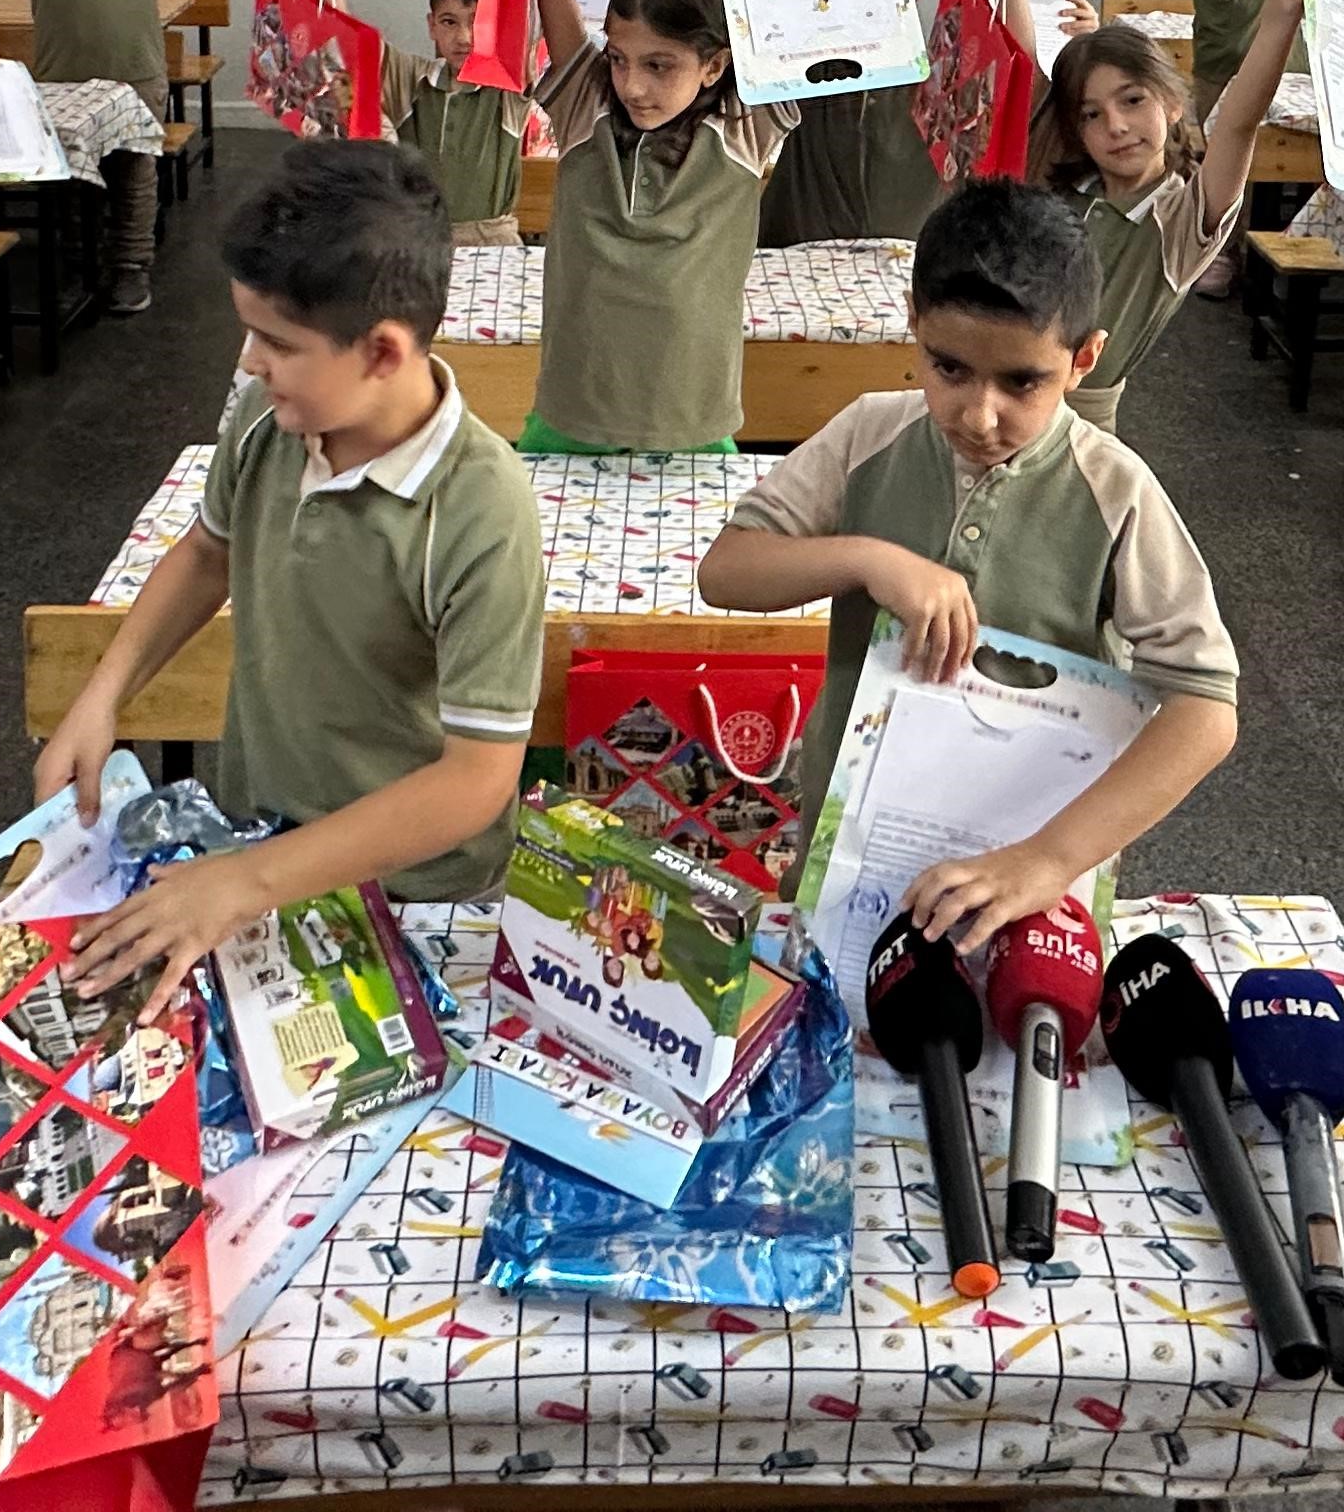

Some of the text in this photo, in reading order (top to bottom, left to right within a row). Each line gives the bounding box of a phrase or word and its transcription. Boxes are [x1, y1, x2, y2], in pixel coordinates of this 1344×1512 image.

[868, 932, 909, 987] TRT
[1027, 929, 1098, 972] anka
[1118, 961, 1172, 1007] İHA
[1241, 998, 1340, 1022] İLKHA
[609, 993, 703, 1078] İLGİNÇ
[490, 1043, 580, 1092] KİTABI
[584, 1082, 690, 1139] BOYAMA
